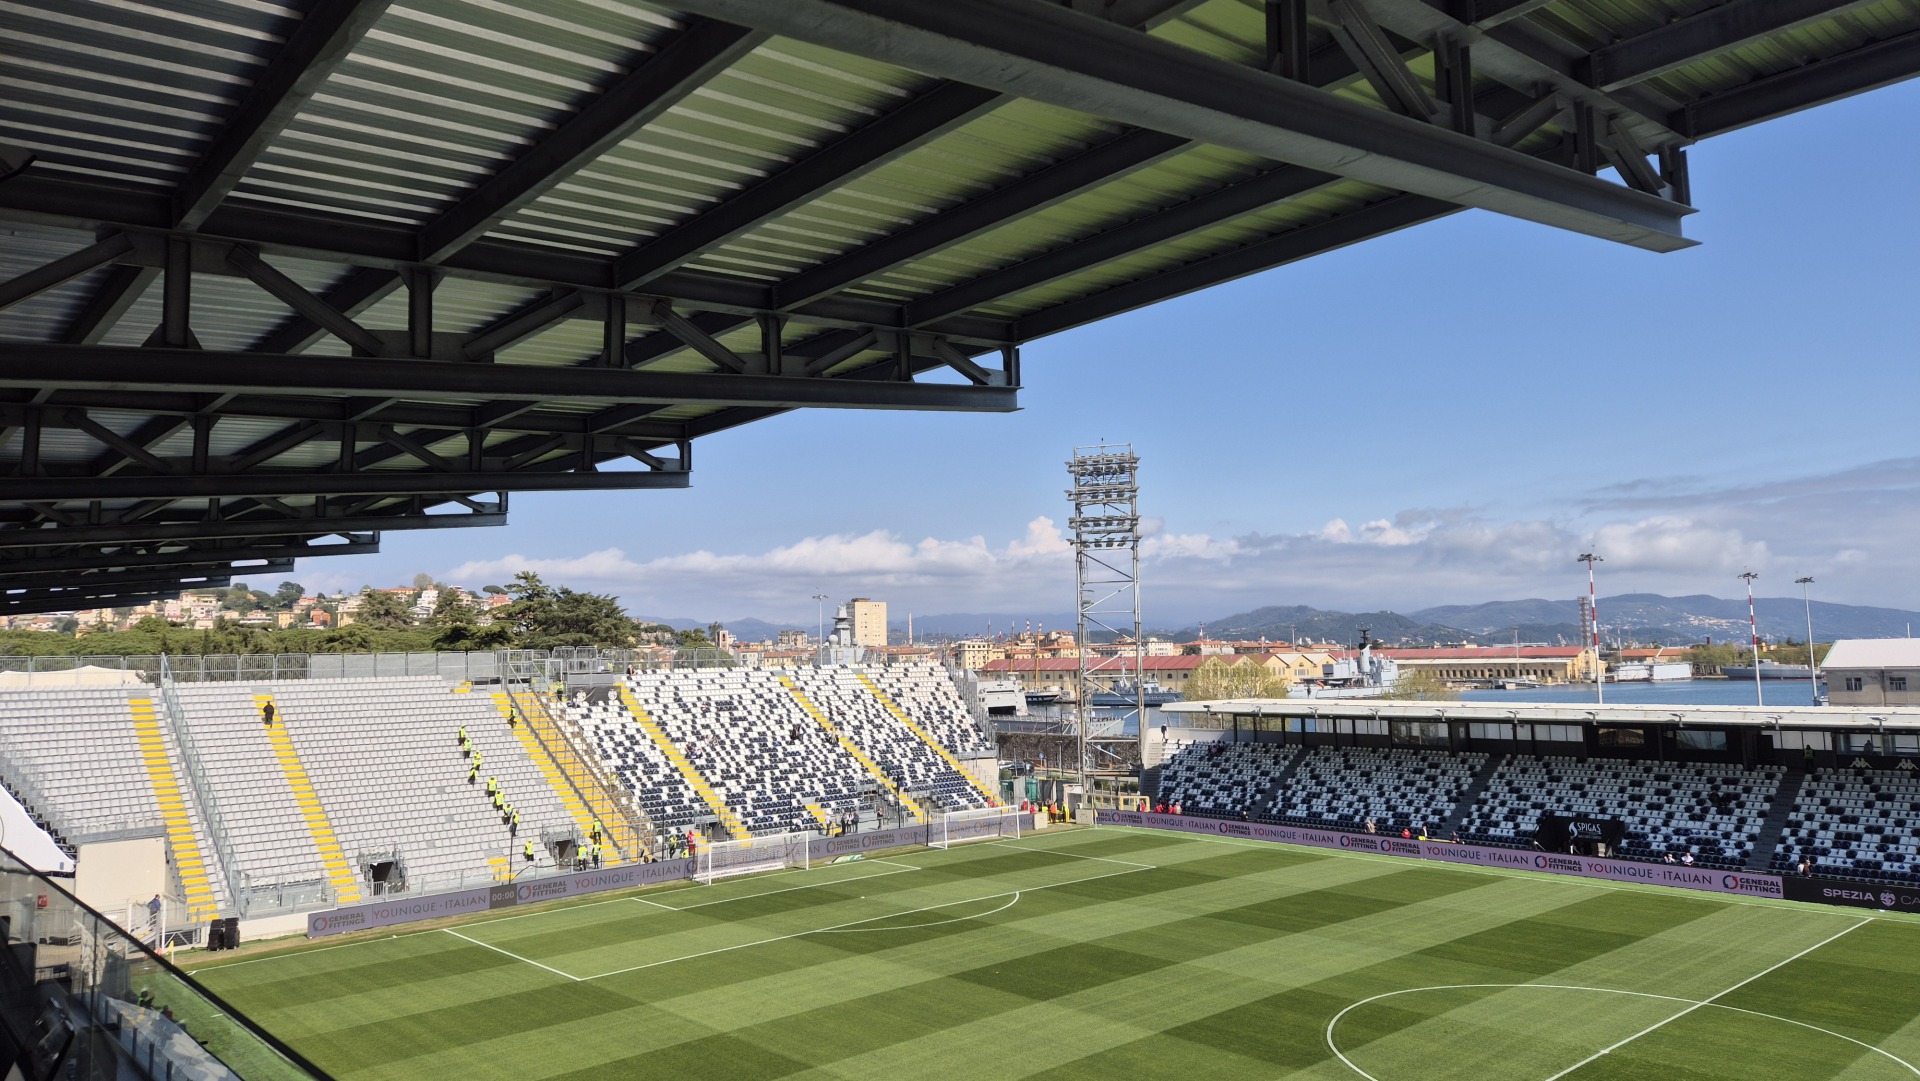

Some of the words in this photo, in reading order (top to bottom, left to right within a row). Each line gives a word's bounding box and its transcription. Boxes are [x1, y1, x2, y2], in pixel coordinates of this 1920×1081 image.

[1146, 816, 1184, 828] YOUNIQUE
[1188, 821, 1216, 831] ITALIAN
[1228, 823, 1251, 831] GENERAL
[1577, 822, 1602, 832] SPIGAS
[872, 832, 895, 841] GENERAL
[1228, 828, 1251, 836] FITTINGS
[1253, 827, 1297, 840] YOUNIQUE
[1302, 833, 1334, 844] ITALIAN
[836, 837, 860, 846] GENERAL
[872, 838, 895, 846] FITTINGS
[1350, 837, 1377, 845] GENERAL
[1350, 842, 1378, 850] FITTINGS
[1392, 841, 1420, 850] GENERAL
[836, 843, 860, 851] FITTINGS
[1392, 847, 1421, 855] FITTINGS
[1426, 845, 1481, 861] YOUNIQUE
[1488, 852, 1529, 865] ITALIAN
[1548, 857, 1582, 866] GENERAL
[1548, 863, 1583, 872] FITTINGS
[574, 871, 634, 889] YOUNIQUE
[642, 864, 681, 880] ITALIAN
[1587, 863, 1653, 879] YOUNIQUE
[1663, 870, 1712, 885] ITALIAN
[532, 880, 567, 891] GENERAL
[1740, 877, 1780, 888] GENERAL
[532, 887, 567, 897] FITTINGS
[1740, 884, 1781, 894] FITTINGS
[492, 890, 515, 901] 00:00
[1823, 888, 1875, 901] SPEZIA
[373, 902, 436, 920] YOUNIQUE
[445, 895, 486, 910] ITALIAN
[329, 911, 365, 923] GENERAL
[329, 918, 365, 929] FITTINGS
